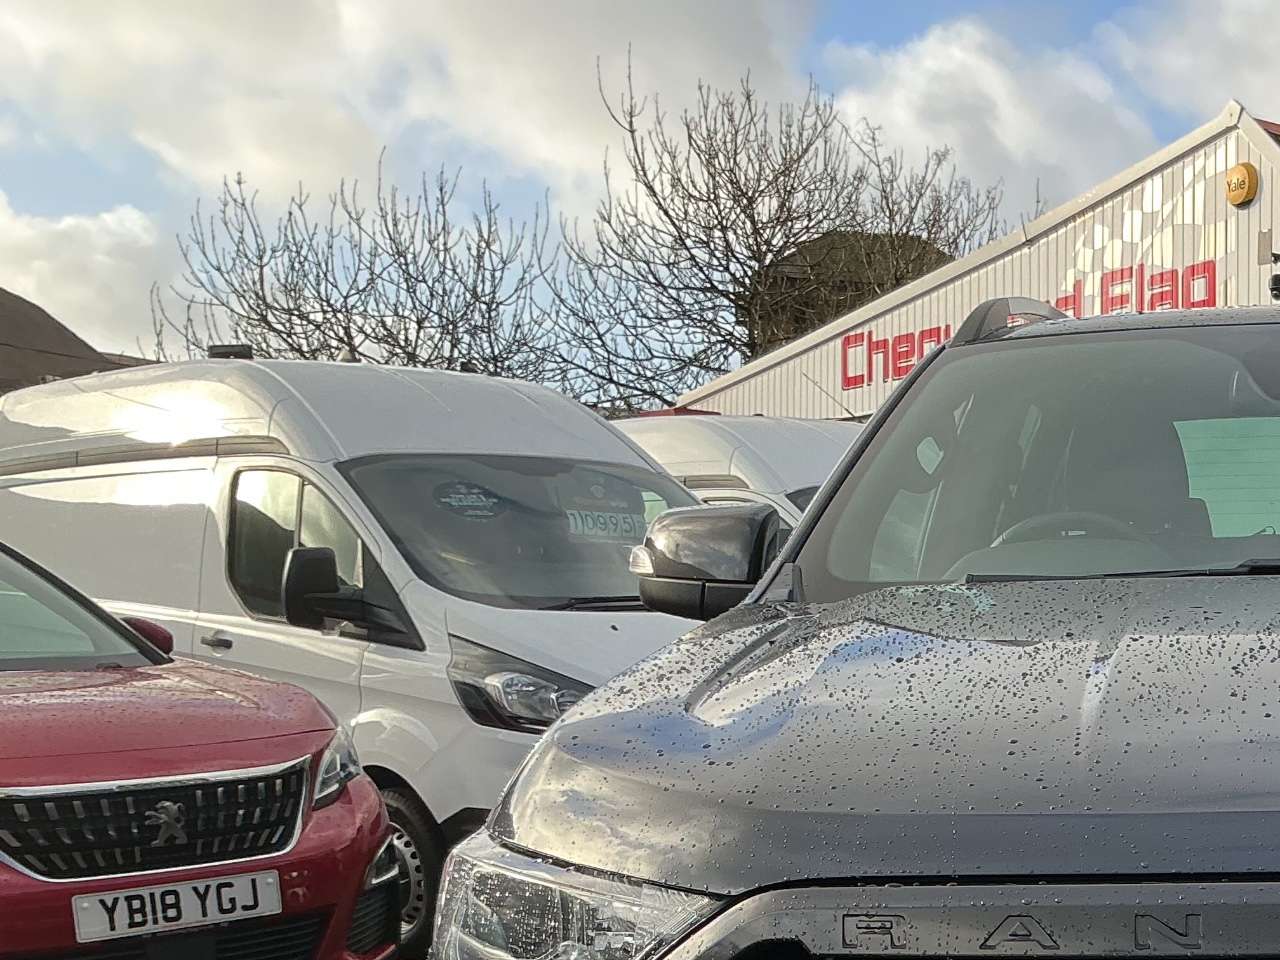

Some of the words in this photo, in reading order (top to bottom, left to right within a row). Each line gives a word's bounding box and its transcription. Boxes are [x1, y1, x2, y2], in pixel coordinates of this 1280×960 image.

[1227, 178, 1246, 192] Yale
[98, 889, 183, 932] YB18
[192, 878, 260, 918] YGJ
